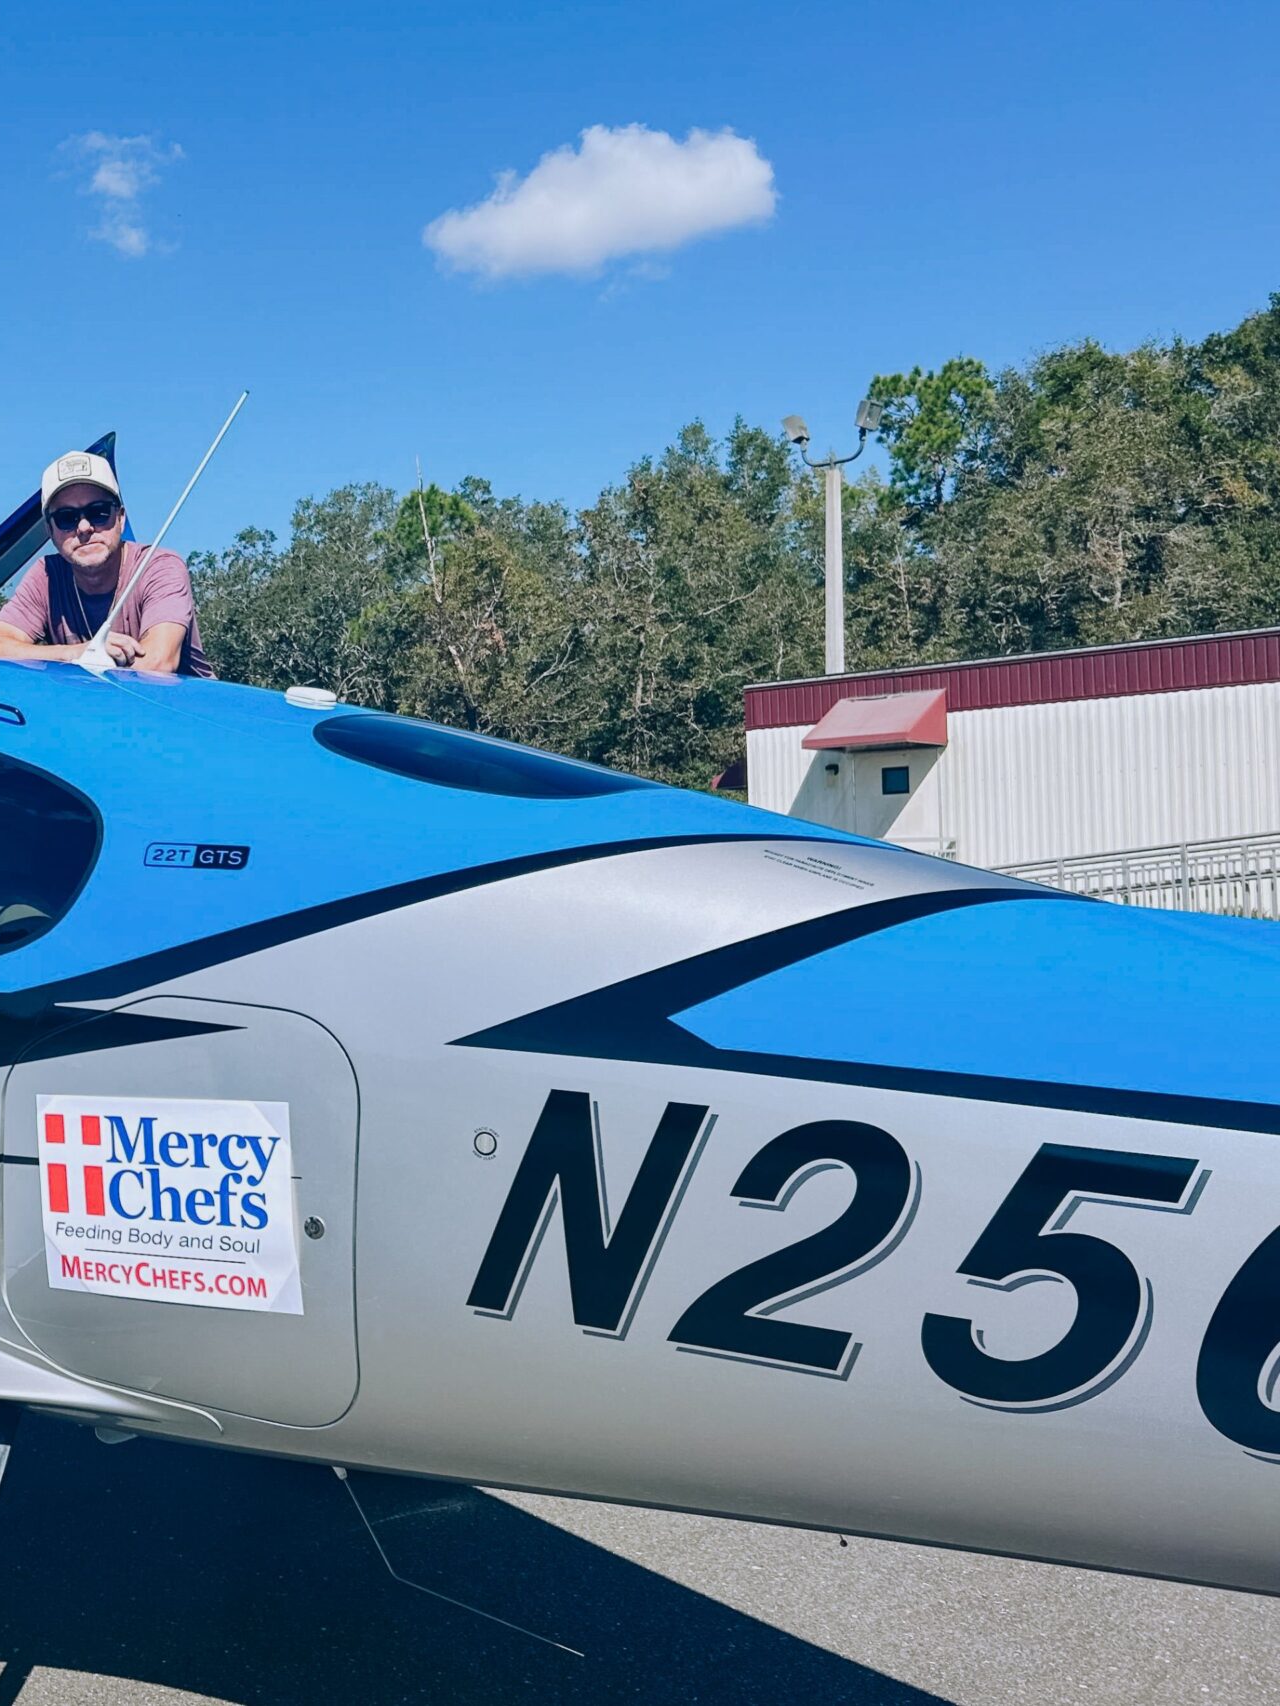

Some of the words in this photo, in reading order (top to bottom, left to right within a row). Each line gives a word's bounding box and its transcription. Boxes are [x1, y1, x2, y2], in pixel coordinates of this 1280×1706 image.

[152, 848, 191, 862] 22T
[199, 849, 243, 865] GTS
[104, 1115, 281, 1187] Mercy
[108, 1168, 269, 1230] Chefs
[55, 1221, 123, 1244] Feeding
[128, 1228, 173, 1249] Body
[178, 1235, 213, 1250] and
[219, 1236, 261, 1254] Soul
